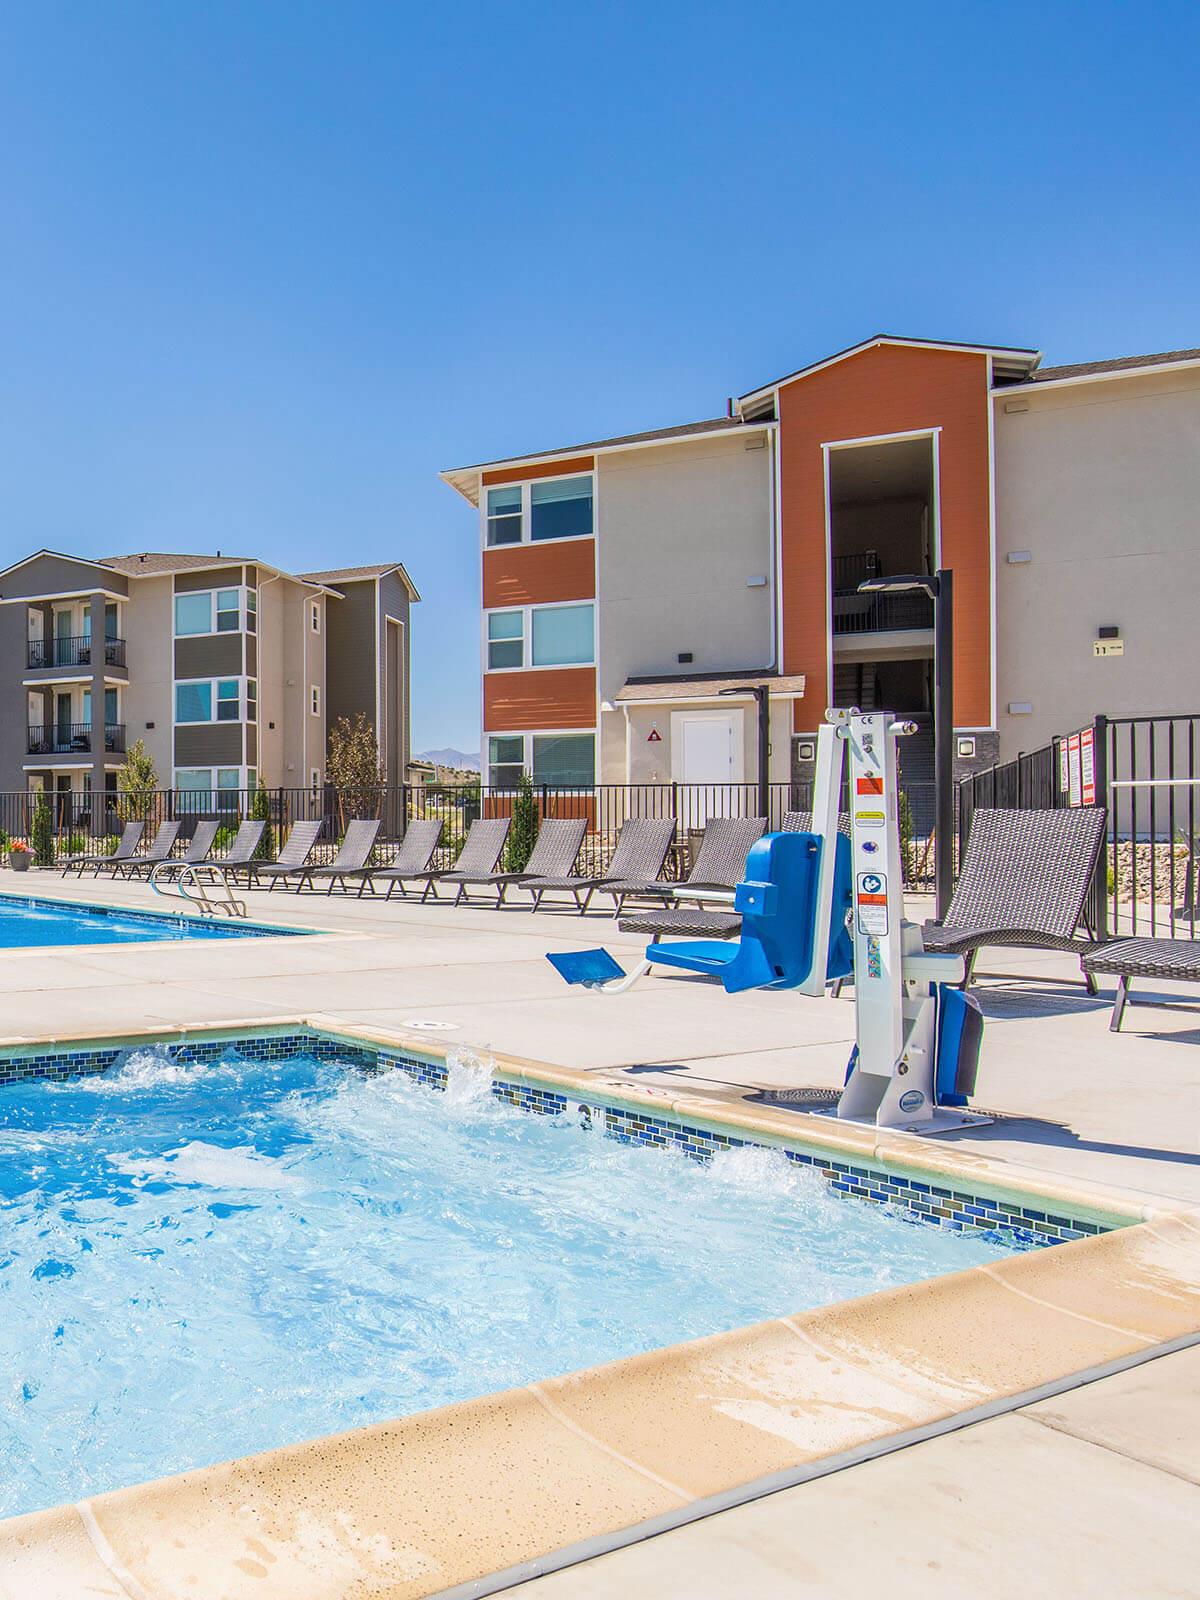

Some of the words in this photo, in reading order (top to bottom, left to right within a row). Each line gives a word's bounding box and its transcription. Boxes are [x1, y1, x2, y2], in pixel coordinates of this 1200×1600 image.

[1095, 647, 1106, 655] 11
[861, 716, 873, 725] CE
[594, 1107, 601, 1118] FT
